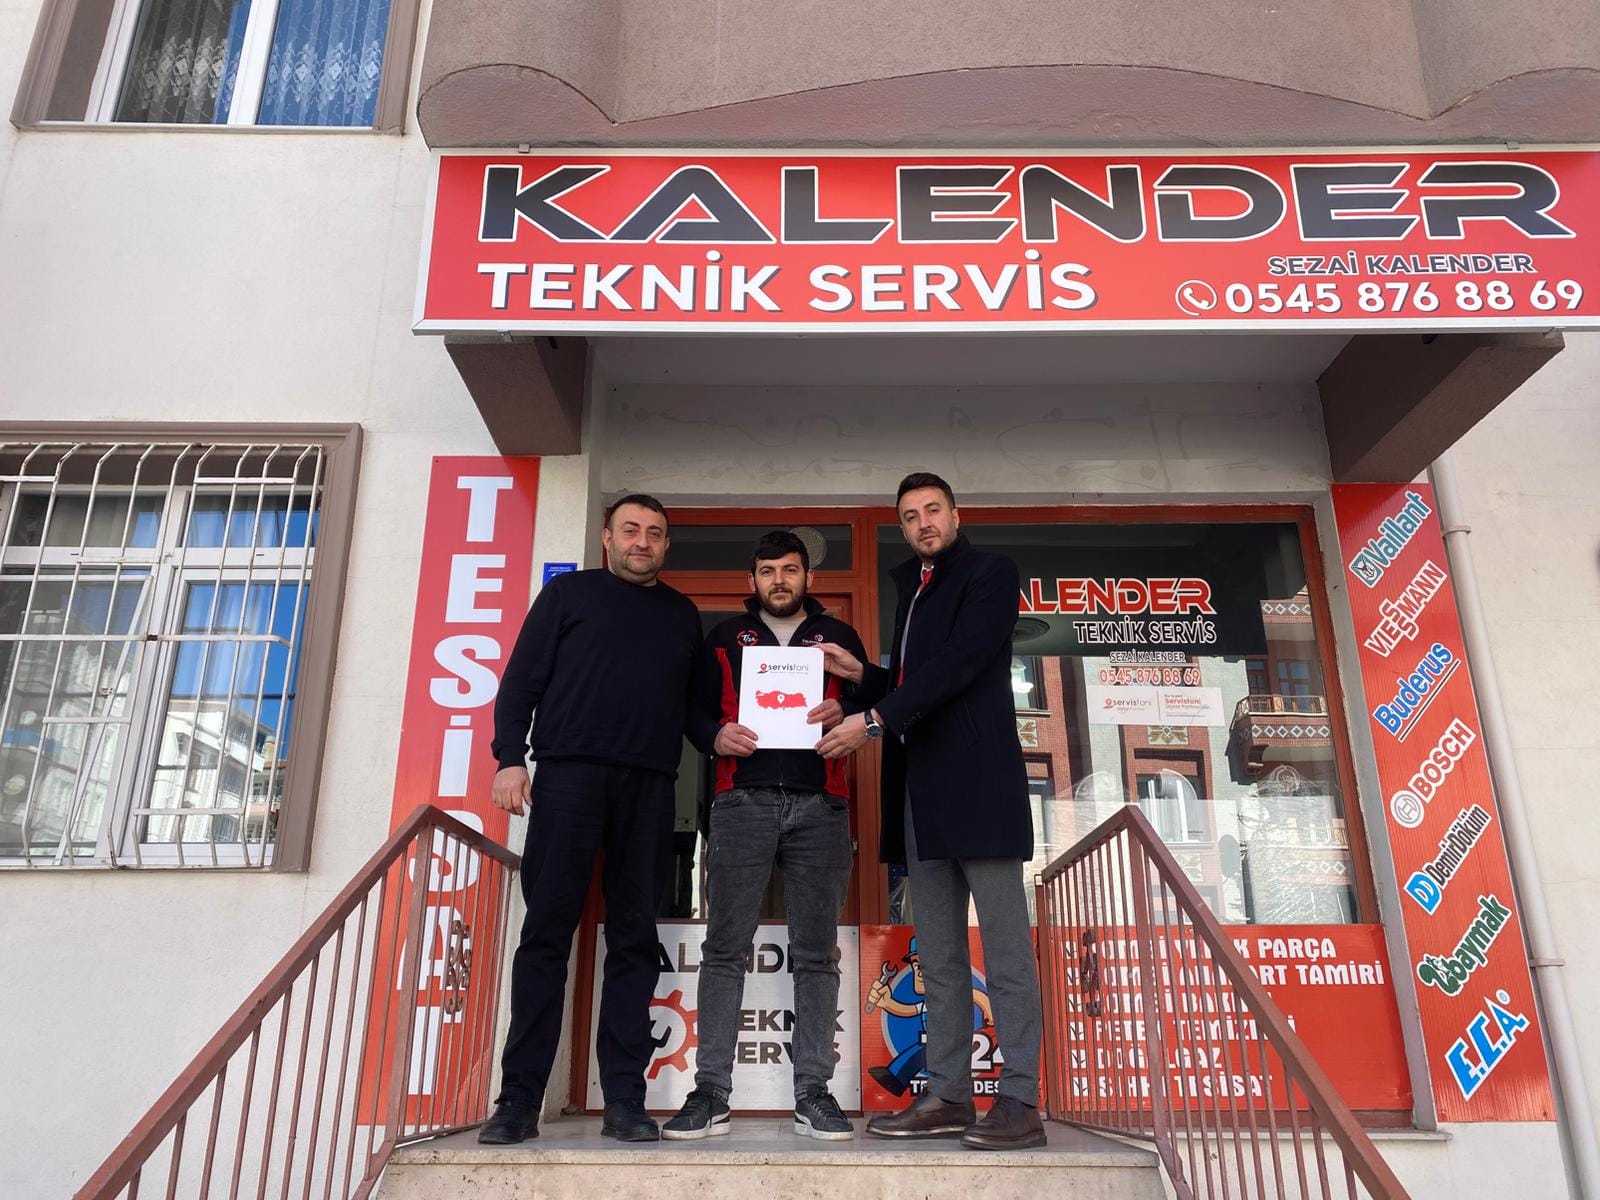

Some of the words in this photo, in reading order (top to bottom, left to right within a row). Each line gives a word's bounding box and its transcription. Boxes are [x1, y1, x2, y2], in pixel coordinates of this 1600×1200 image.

[478, 164, 1576, 243] KALENDER
[477, 250, 784, 313] TEKNİK
[808, 249, 1098, 312] SERVİS
[1268, 250, 1359, 276] SEZAİ
[1367, 252, 1537, 276] KALENDER
[1225, 282, 1342, 313] 0545
[1357, 281, 1440, 313] 876
[1455, 280, 1515, 312] 88
[1523, 279, 1584, 311] 69
[1363, 492, 1431, 567] Vaillant
[1018, 578, 1217, 614] LENDER
[1073, 615, 1147, 643] TEKNİK
[1149, 615, 1217, 643] SERVİS
[1137, 652, 1187, 662] KALENDER
[1100, 668, 1133, 685] 0545
[1136, 668, 1160, 685] 876
[1162, 668, 1182, 685] 88
[1184, 668, 1200, 685] 69
[1374, 643, 1453, 736] Buderus
[1409, 718, 1475, 802] BOSCH
[1424, 805, 1490, 887] DemirDöküm
[1258, 937, 1336, 961] PARÇA
[1446, 895, 1511, 985] baymak
[1296, 960, 1385, 985] TAMİRİ
